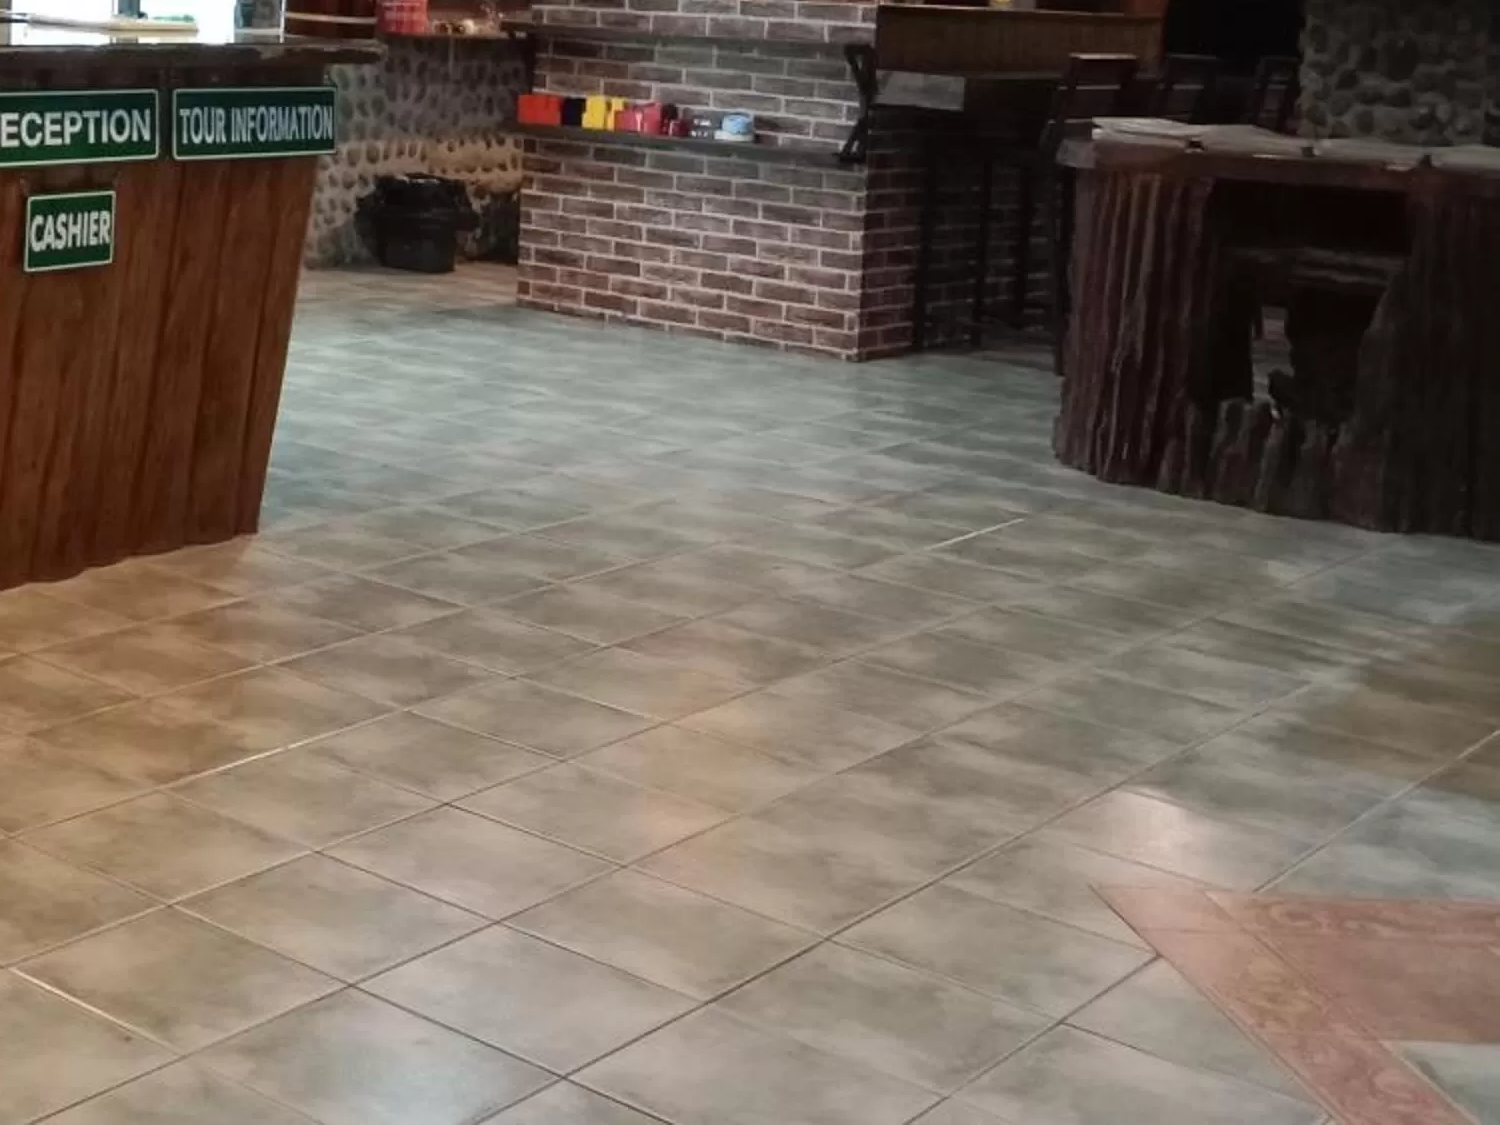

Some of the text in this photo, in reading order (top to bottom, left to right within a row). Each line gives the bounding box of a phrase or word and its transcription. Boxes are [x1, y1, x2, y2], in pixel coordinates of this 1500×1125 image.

[180, 104, 334, 145] TOUR INFORMATION
[29, 210, 112, 253] CASHIER
